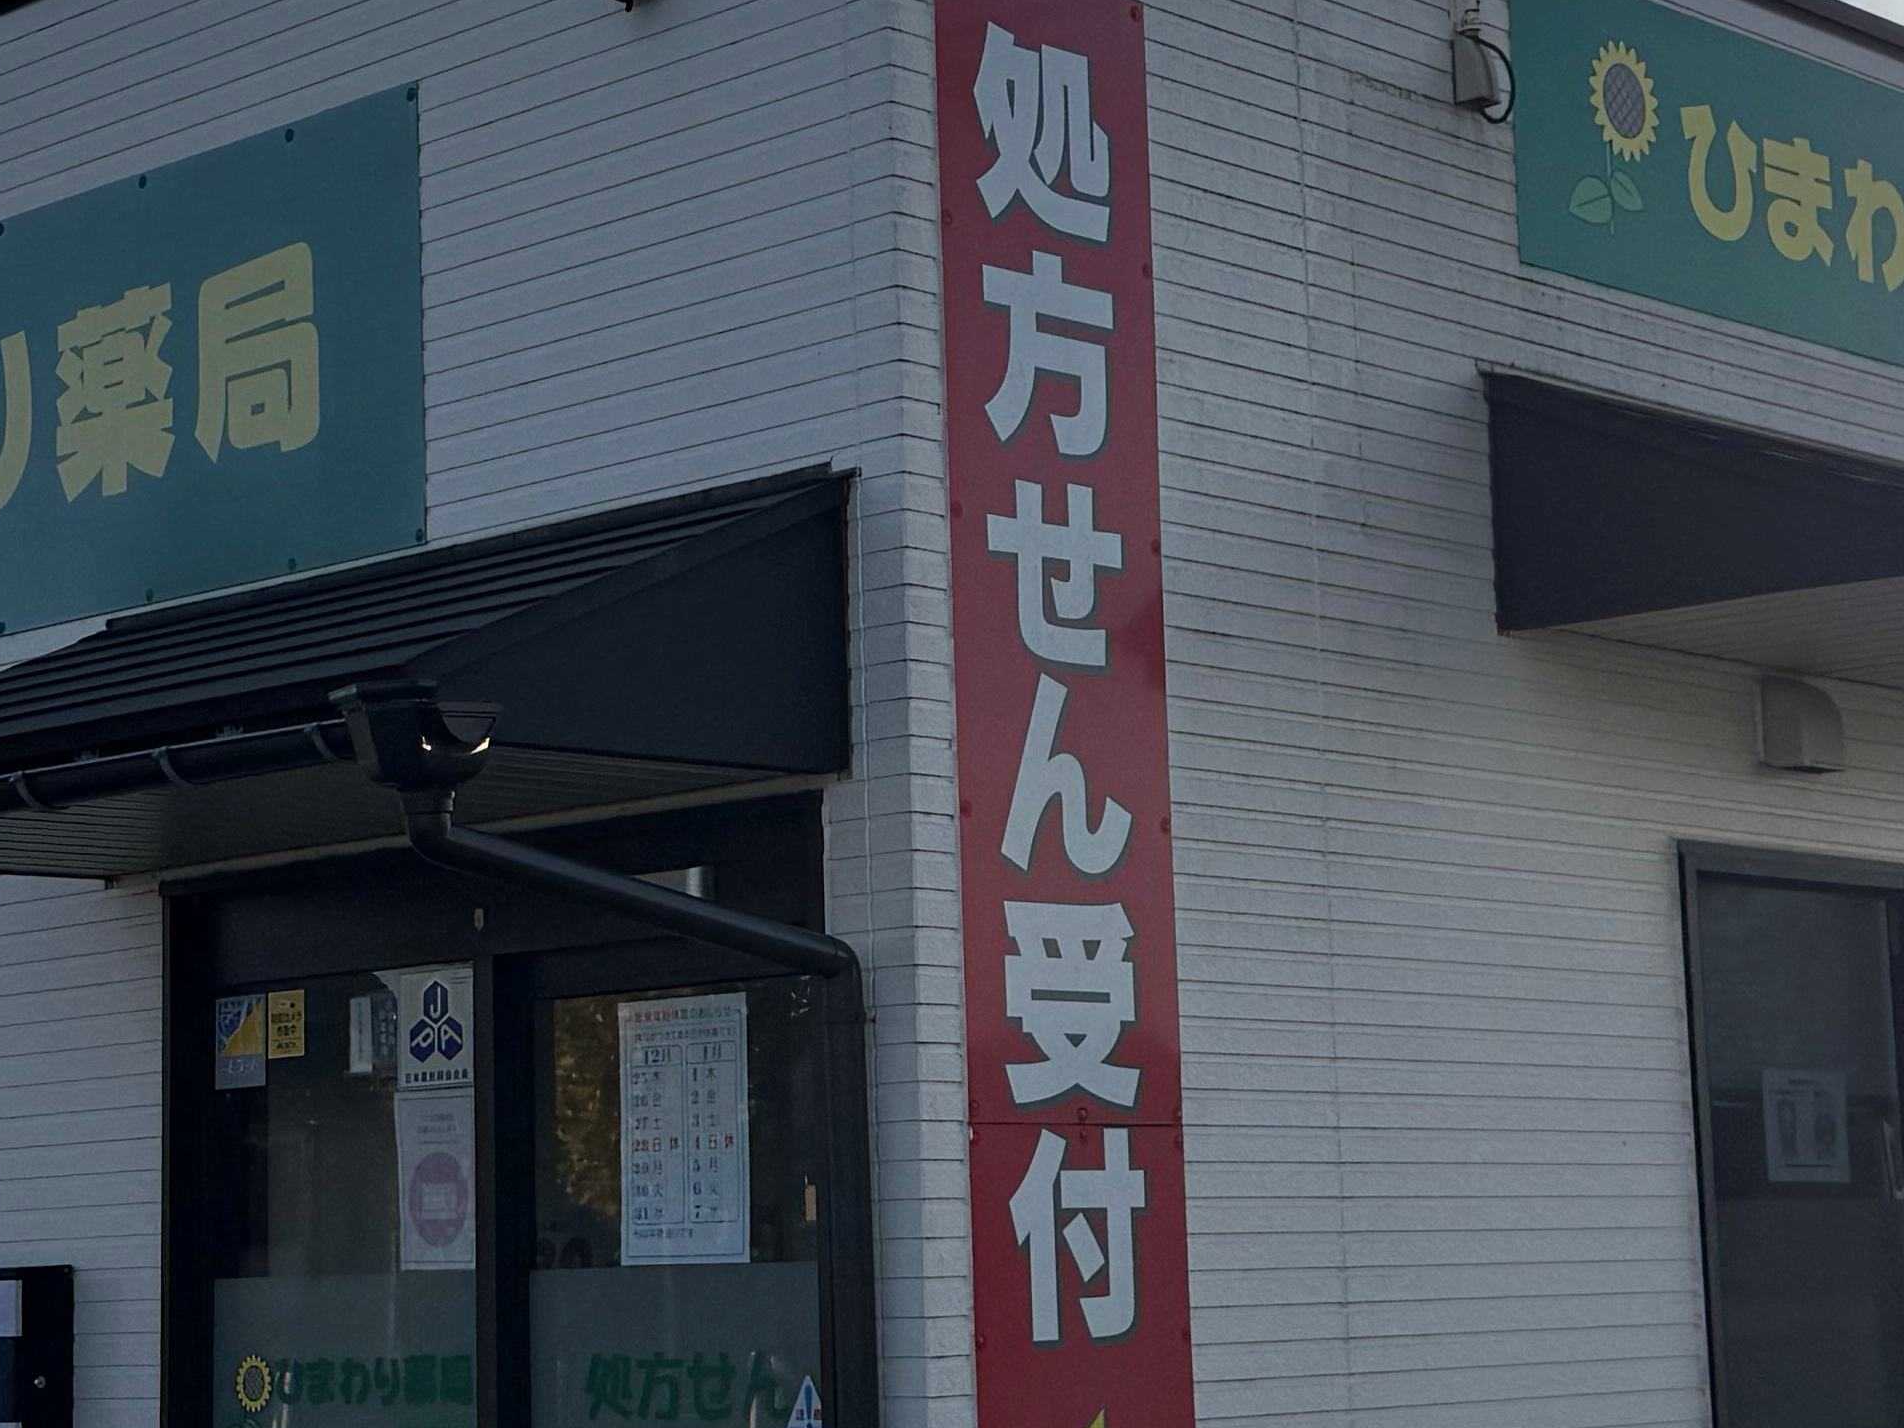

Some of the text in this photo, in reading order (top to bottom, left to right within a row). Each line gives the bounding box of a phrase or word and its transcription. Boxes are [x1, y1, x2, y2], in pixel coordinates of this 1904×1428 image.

[969, 18, 1149, 1349] 処方せん受付
